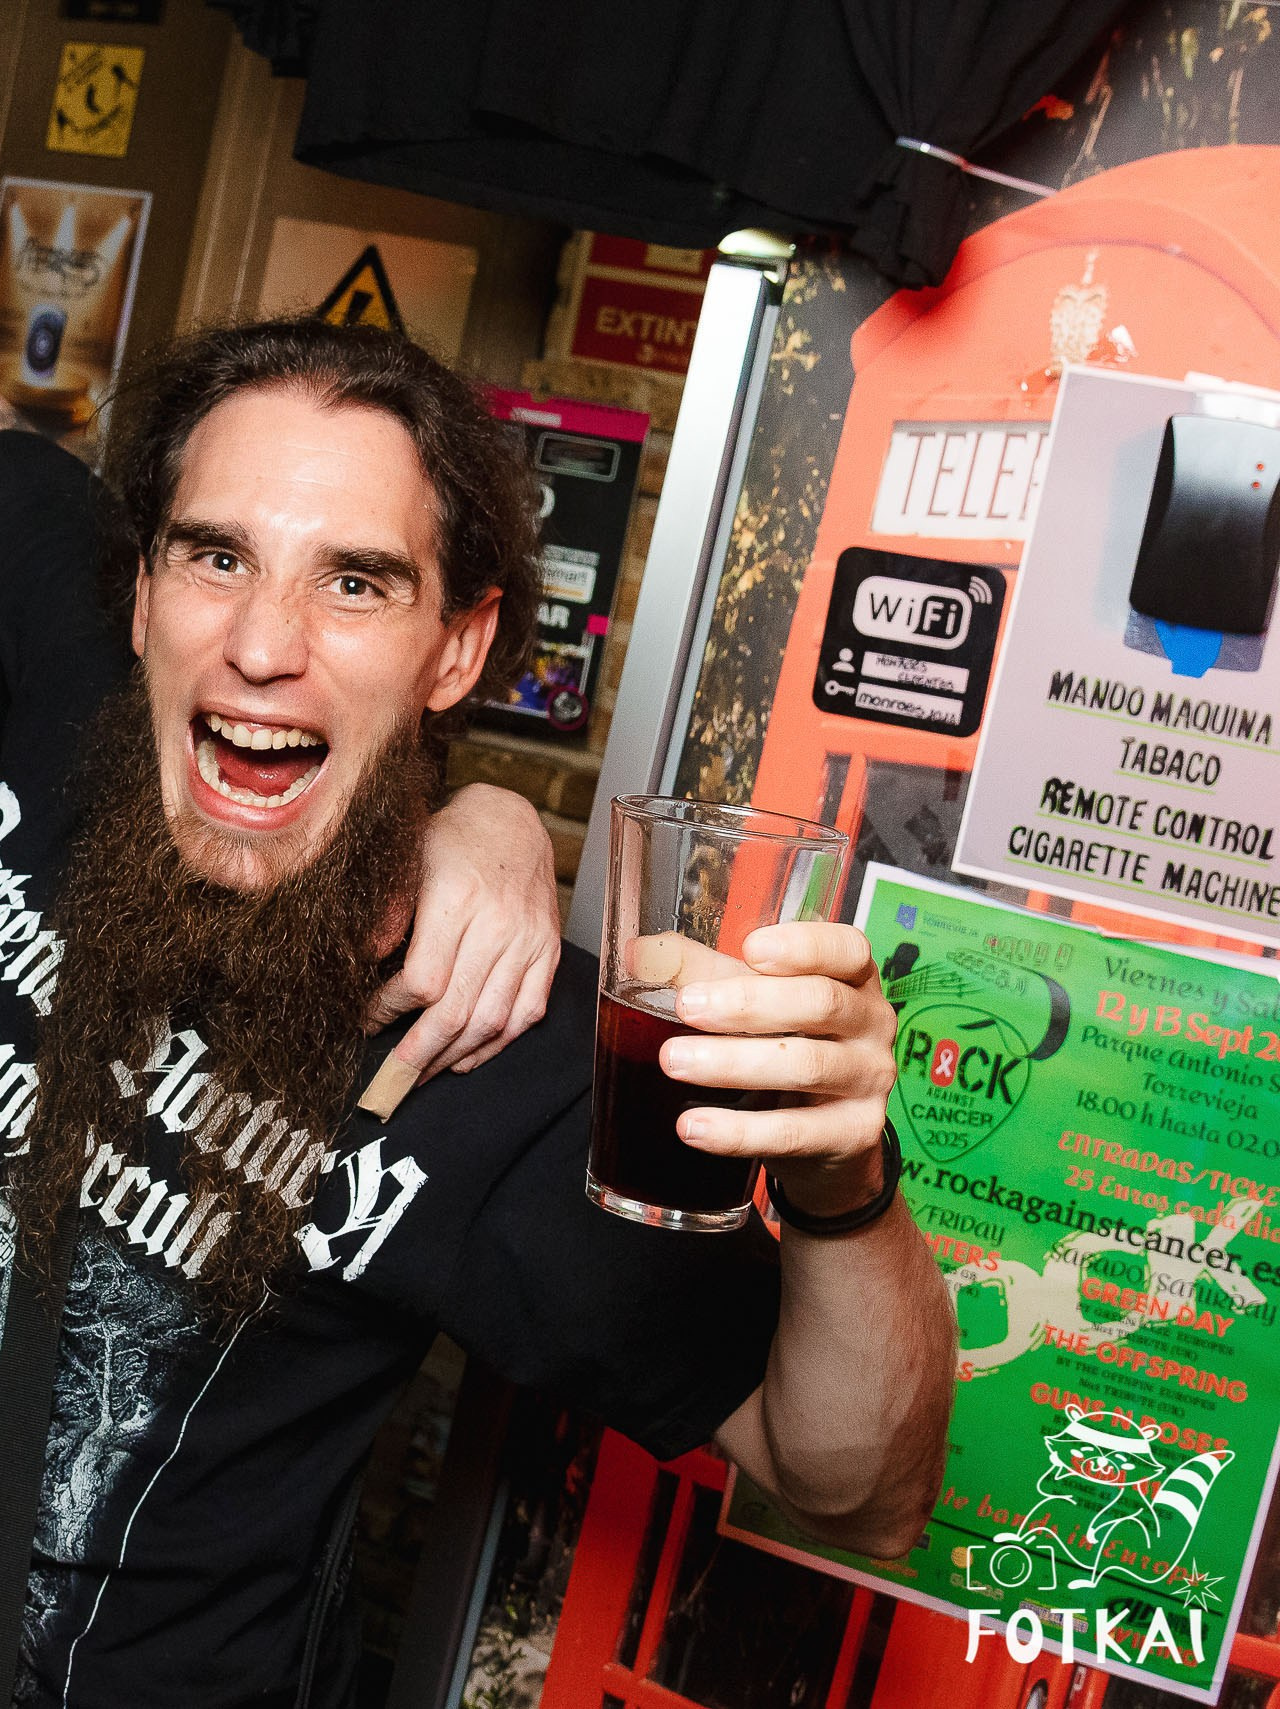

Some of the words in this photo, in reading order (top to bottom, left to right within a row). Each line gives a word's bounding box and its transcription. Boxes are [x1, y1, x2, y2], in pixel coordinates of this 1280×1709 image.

[596, 306, 698, 345] EXTIN
[870, 592, 958, 636] WiFi
[1048, 669, 1144, 716] MANDO
[1150, 690, 1272, 745] MAQUINA
[1120, 736, 1221, 786] TABACO
[1040, 777, 1147, 830] REMOTE
[1153, 804, 1274, 860] CONTROL
[1009, 826, 1149, 884] CIGARETTE
[1161, 860, 1280, 916] MACHINE
[1105, 956, 1205, 999] Viernes
[1081, 1026, 1163, 1062] Parque
[1168, 1050, 1264, 1087] Antonio
[1184, 1012, 1253, 1059] Sept
[911, 1103, 993, 1127] CANCER
[1142, 1073, 1258, 1120] Torrevieja
[924, 1130, 969, 1148] 2025
[1076, 1090, 1136, 1119] 18.00
[1160, 1107, 1220, 1144] hasta
[1227, 1130, 1280, 1158] 02.0
[1058, 1131, 1280, 1206] ENTRADAS/TICKE
[899, 1157, 1280, 1287] w.rockagainstcancer.es
[1064, 1166, 1094, 1191] 25
[1098, 1176, 1169, 1212] Euros
[1175, 1201, 1236, 1229] cada
[924, 1232, 1001, 1271] HTERS
[1081, 1278, 1169, 1321] GREEN
[1176, 1304, 1234, 1337] DAY
[1044, 1324, 1090, 1356] THE
[1096, 1341, 1248, 1403] OFFSPRING
[1030, 1382, 1106, 1421] GUNS
